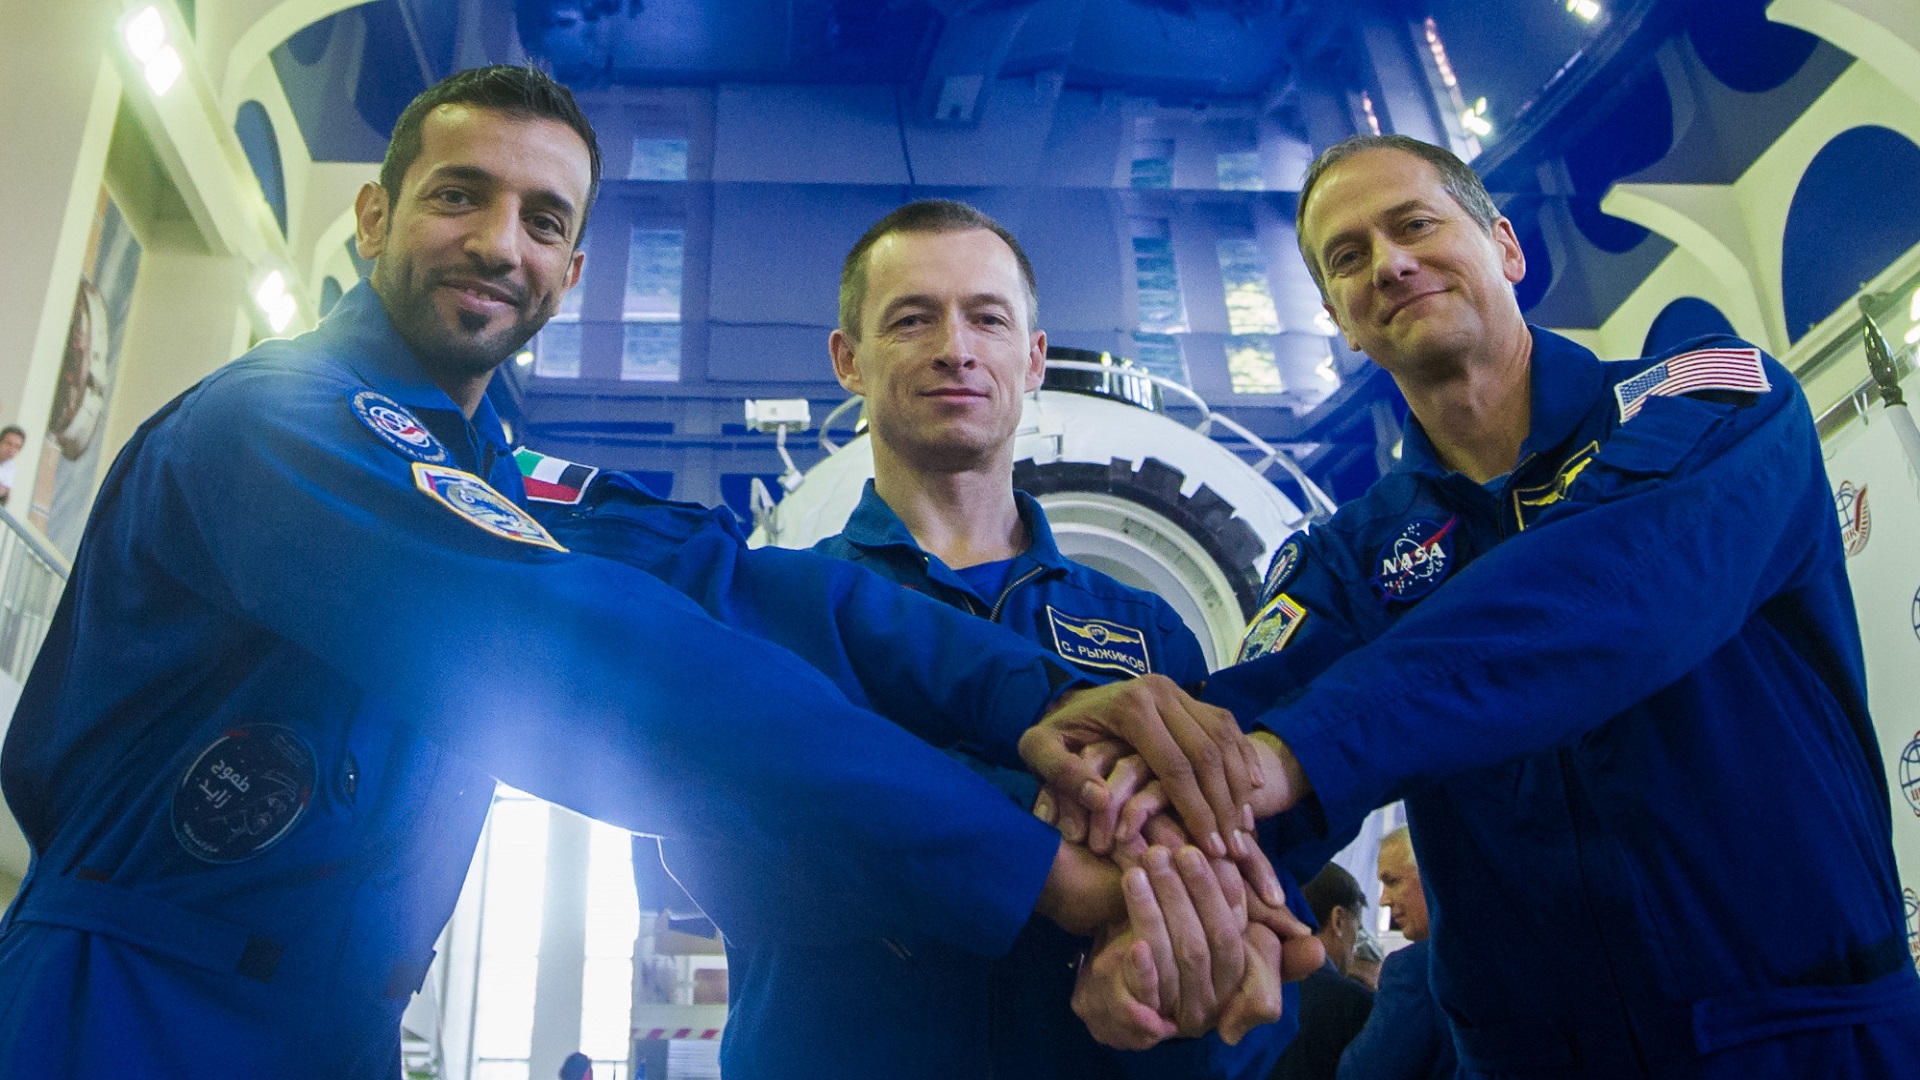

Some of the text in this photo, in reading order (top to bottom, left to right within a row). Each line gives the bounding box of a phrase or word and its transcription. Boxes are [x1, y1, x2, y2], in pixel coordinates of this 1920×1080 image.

[1382, 542, 1447, 576] NASA
[1078, 645, 1146, 672] РЫЖИКОВ
[210, 758, 250, 793] طموح
